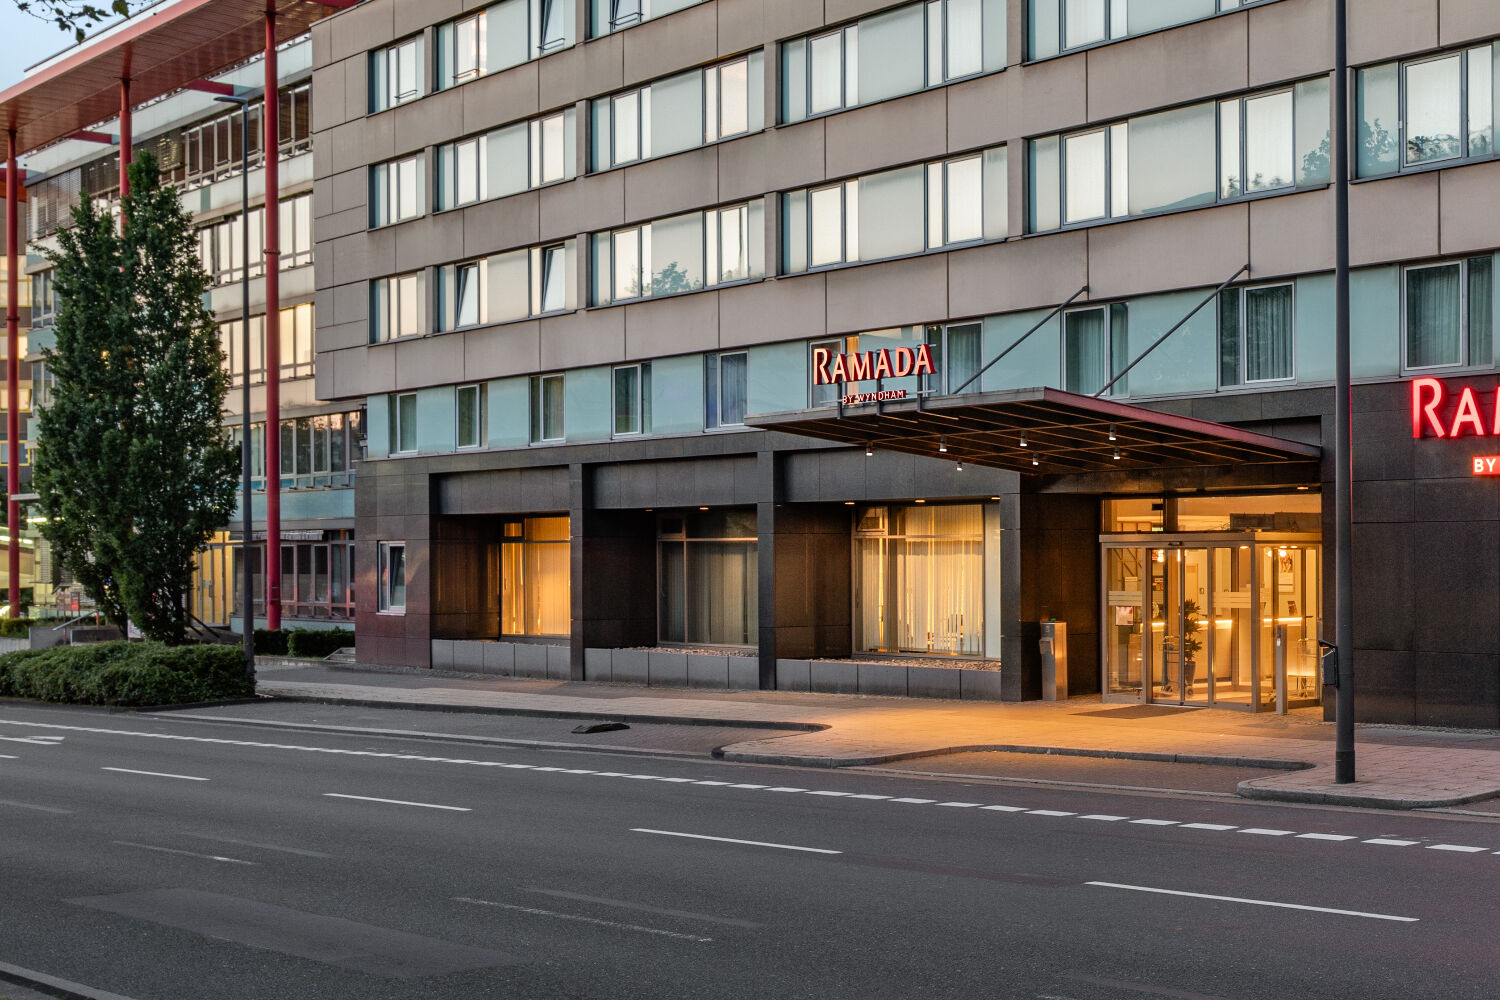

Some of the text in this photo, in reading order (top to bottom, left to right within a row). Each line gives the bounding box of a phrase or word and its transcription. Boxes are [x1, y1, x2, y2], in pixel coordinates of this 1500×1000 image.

[813, 344, 935, 385] RAMADA
[842, 390, 904, 404] BY WYNDHAM
[1473, 457, 1496, 473] BY
